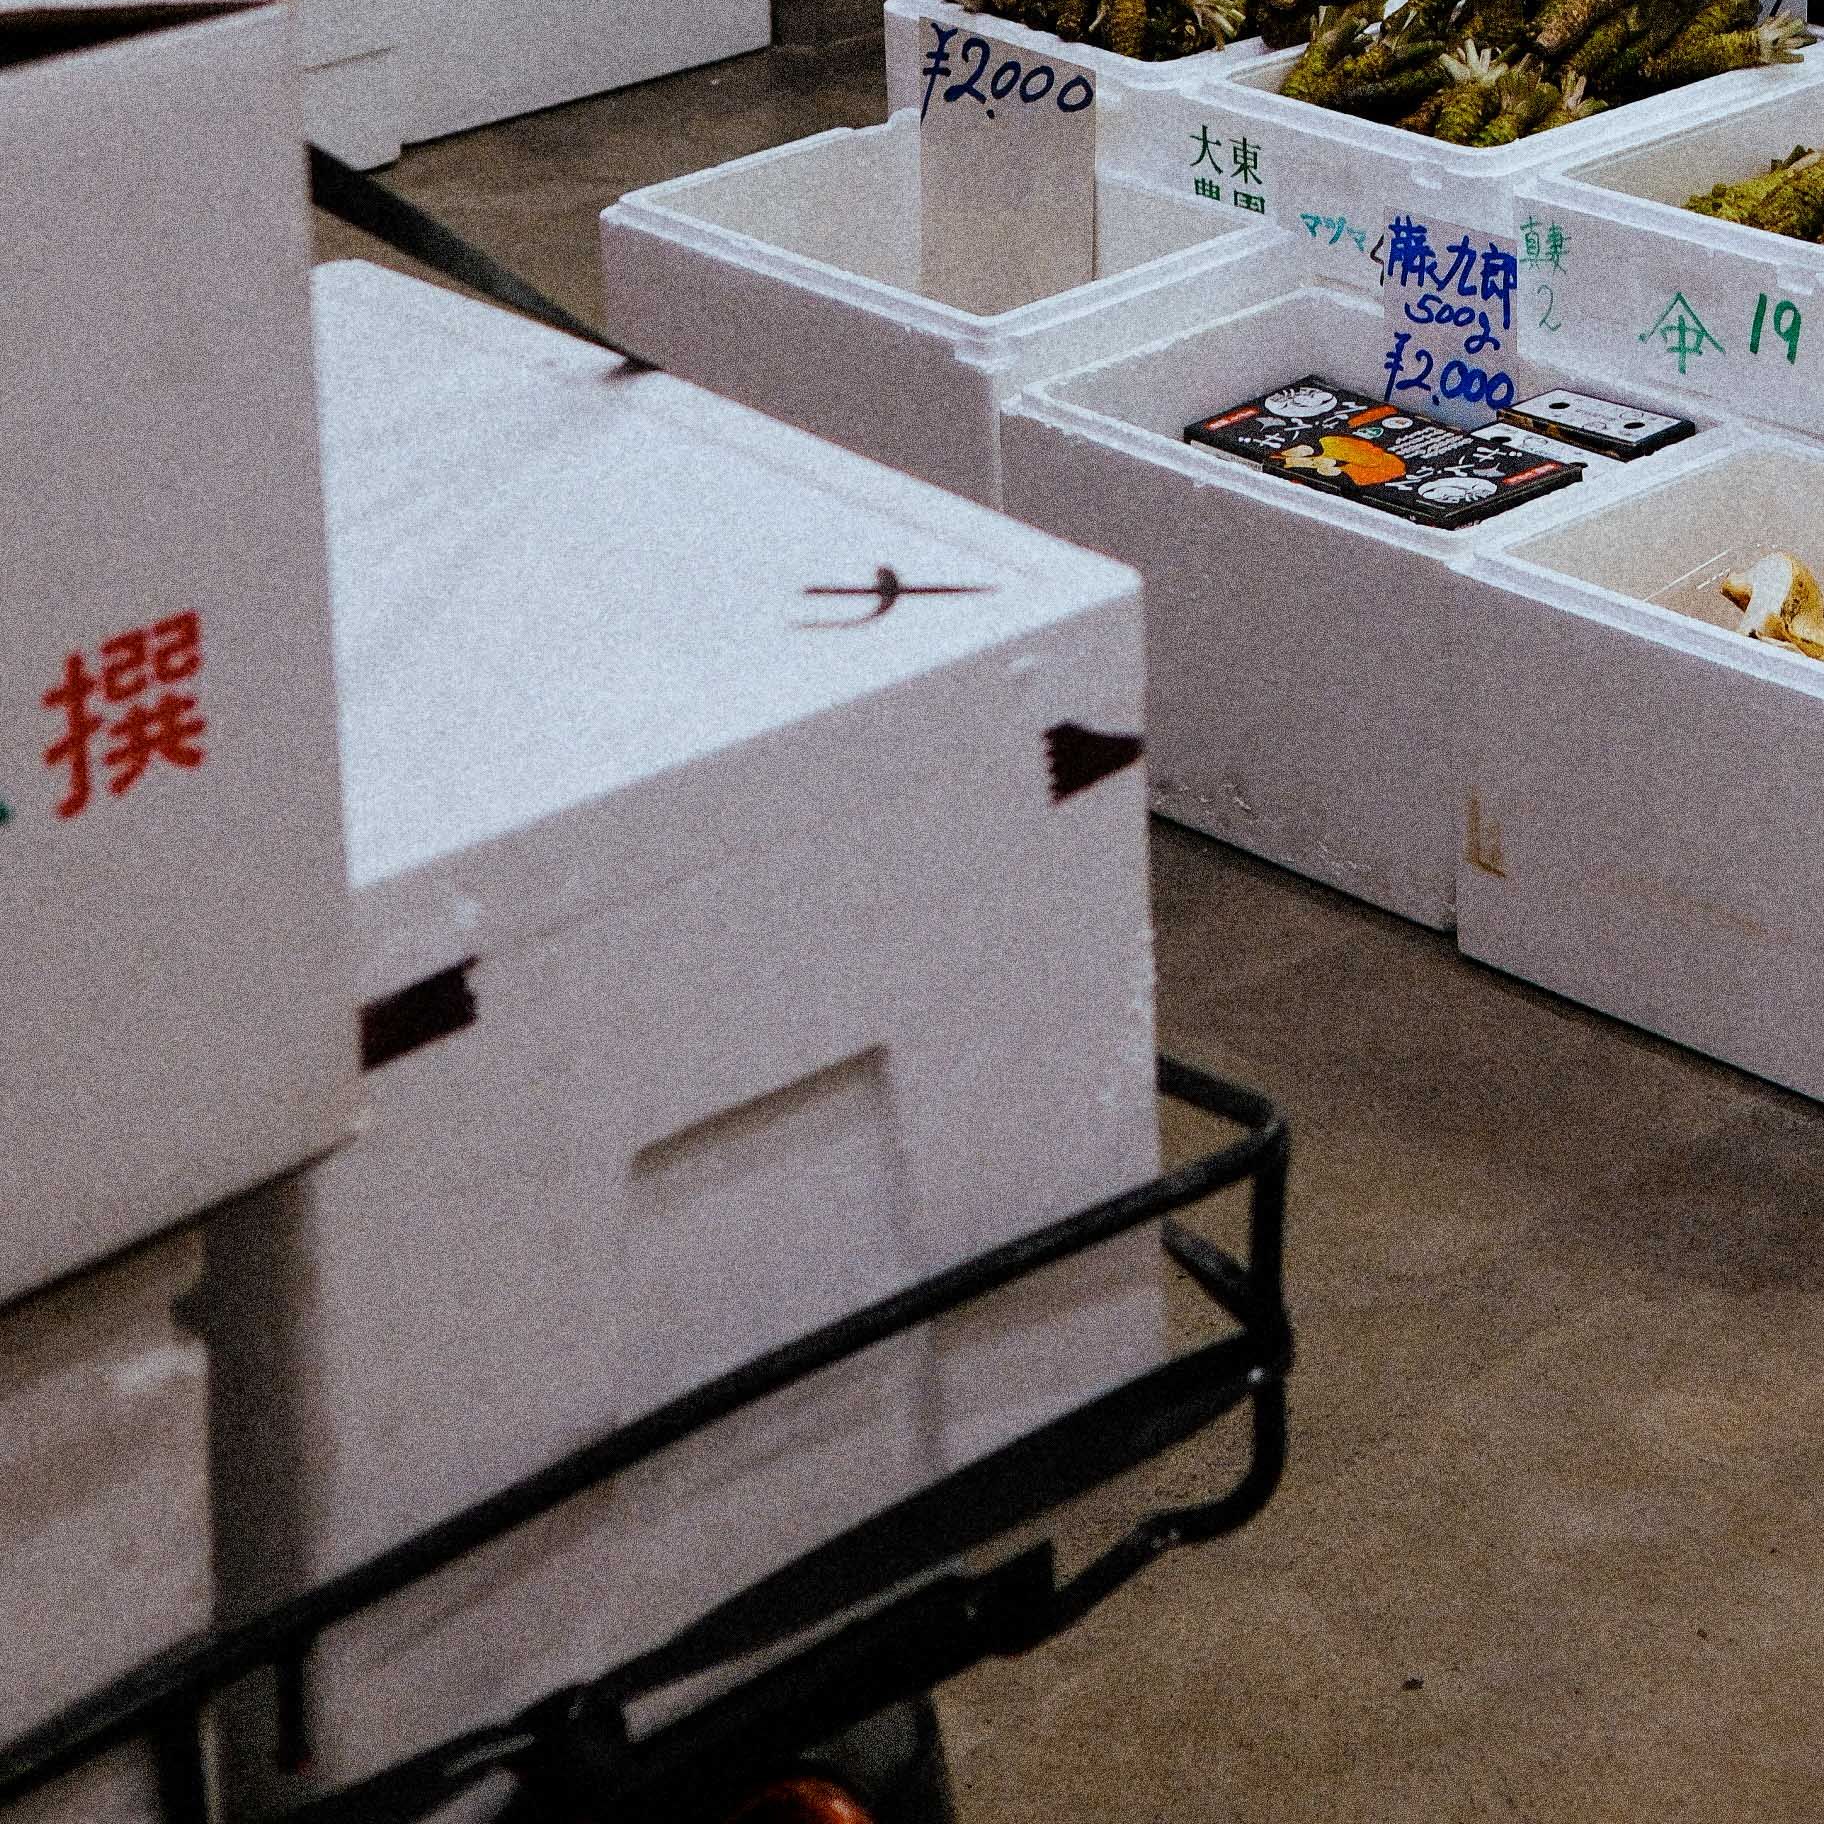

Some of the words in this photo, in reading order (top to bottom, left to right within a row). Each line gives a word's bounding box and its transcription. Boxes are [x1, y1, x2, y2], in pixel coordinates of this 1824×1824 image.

[1190, 124, 1264, 185] 大東
[1387, 214, 1517, 328] 藤九郎
[1749, 292, 1801, 365] 19
[42, 608, 206, 820] 撰
